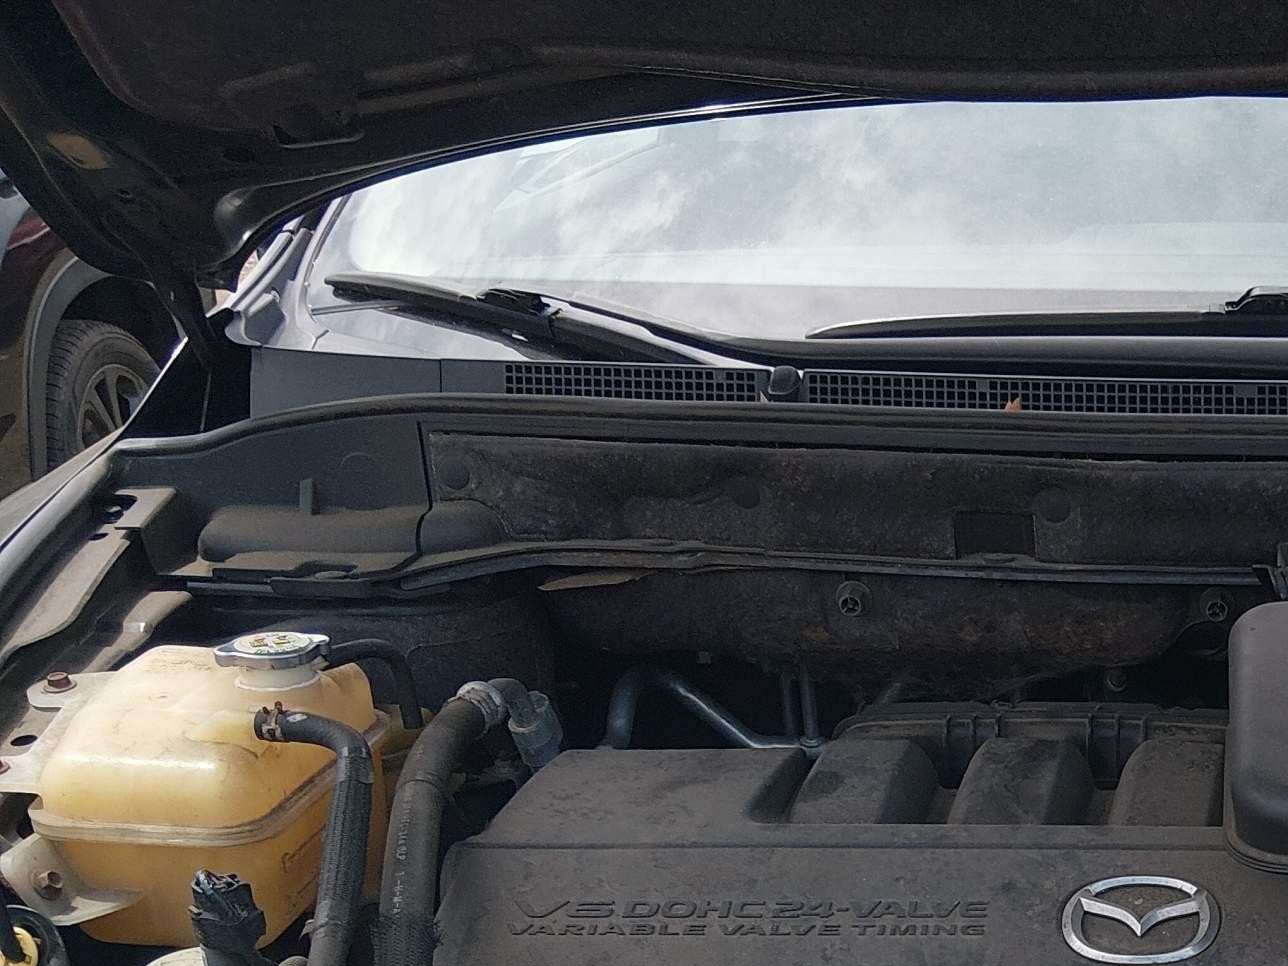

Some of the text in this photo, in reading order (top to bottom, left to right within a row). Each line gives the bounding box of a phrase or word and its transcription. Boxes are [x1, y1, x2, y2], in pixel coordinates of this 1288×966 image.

[514, 900, 989, 919] V6 DOHC 24-VALVE
[507, 923, 986, 937] VARIABLE VALVE TIMING
